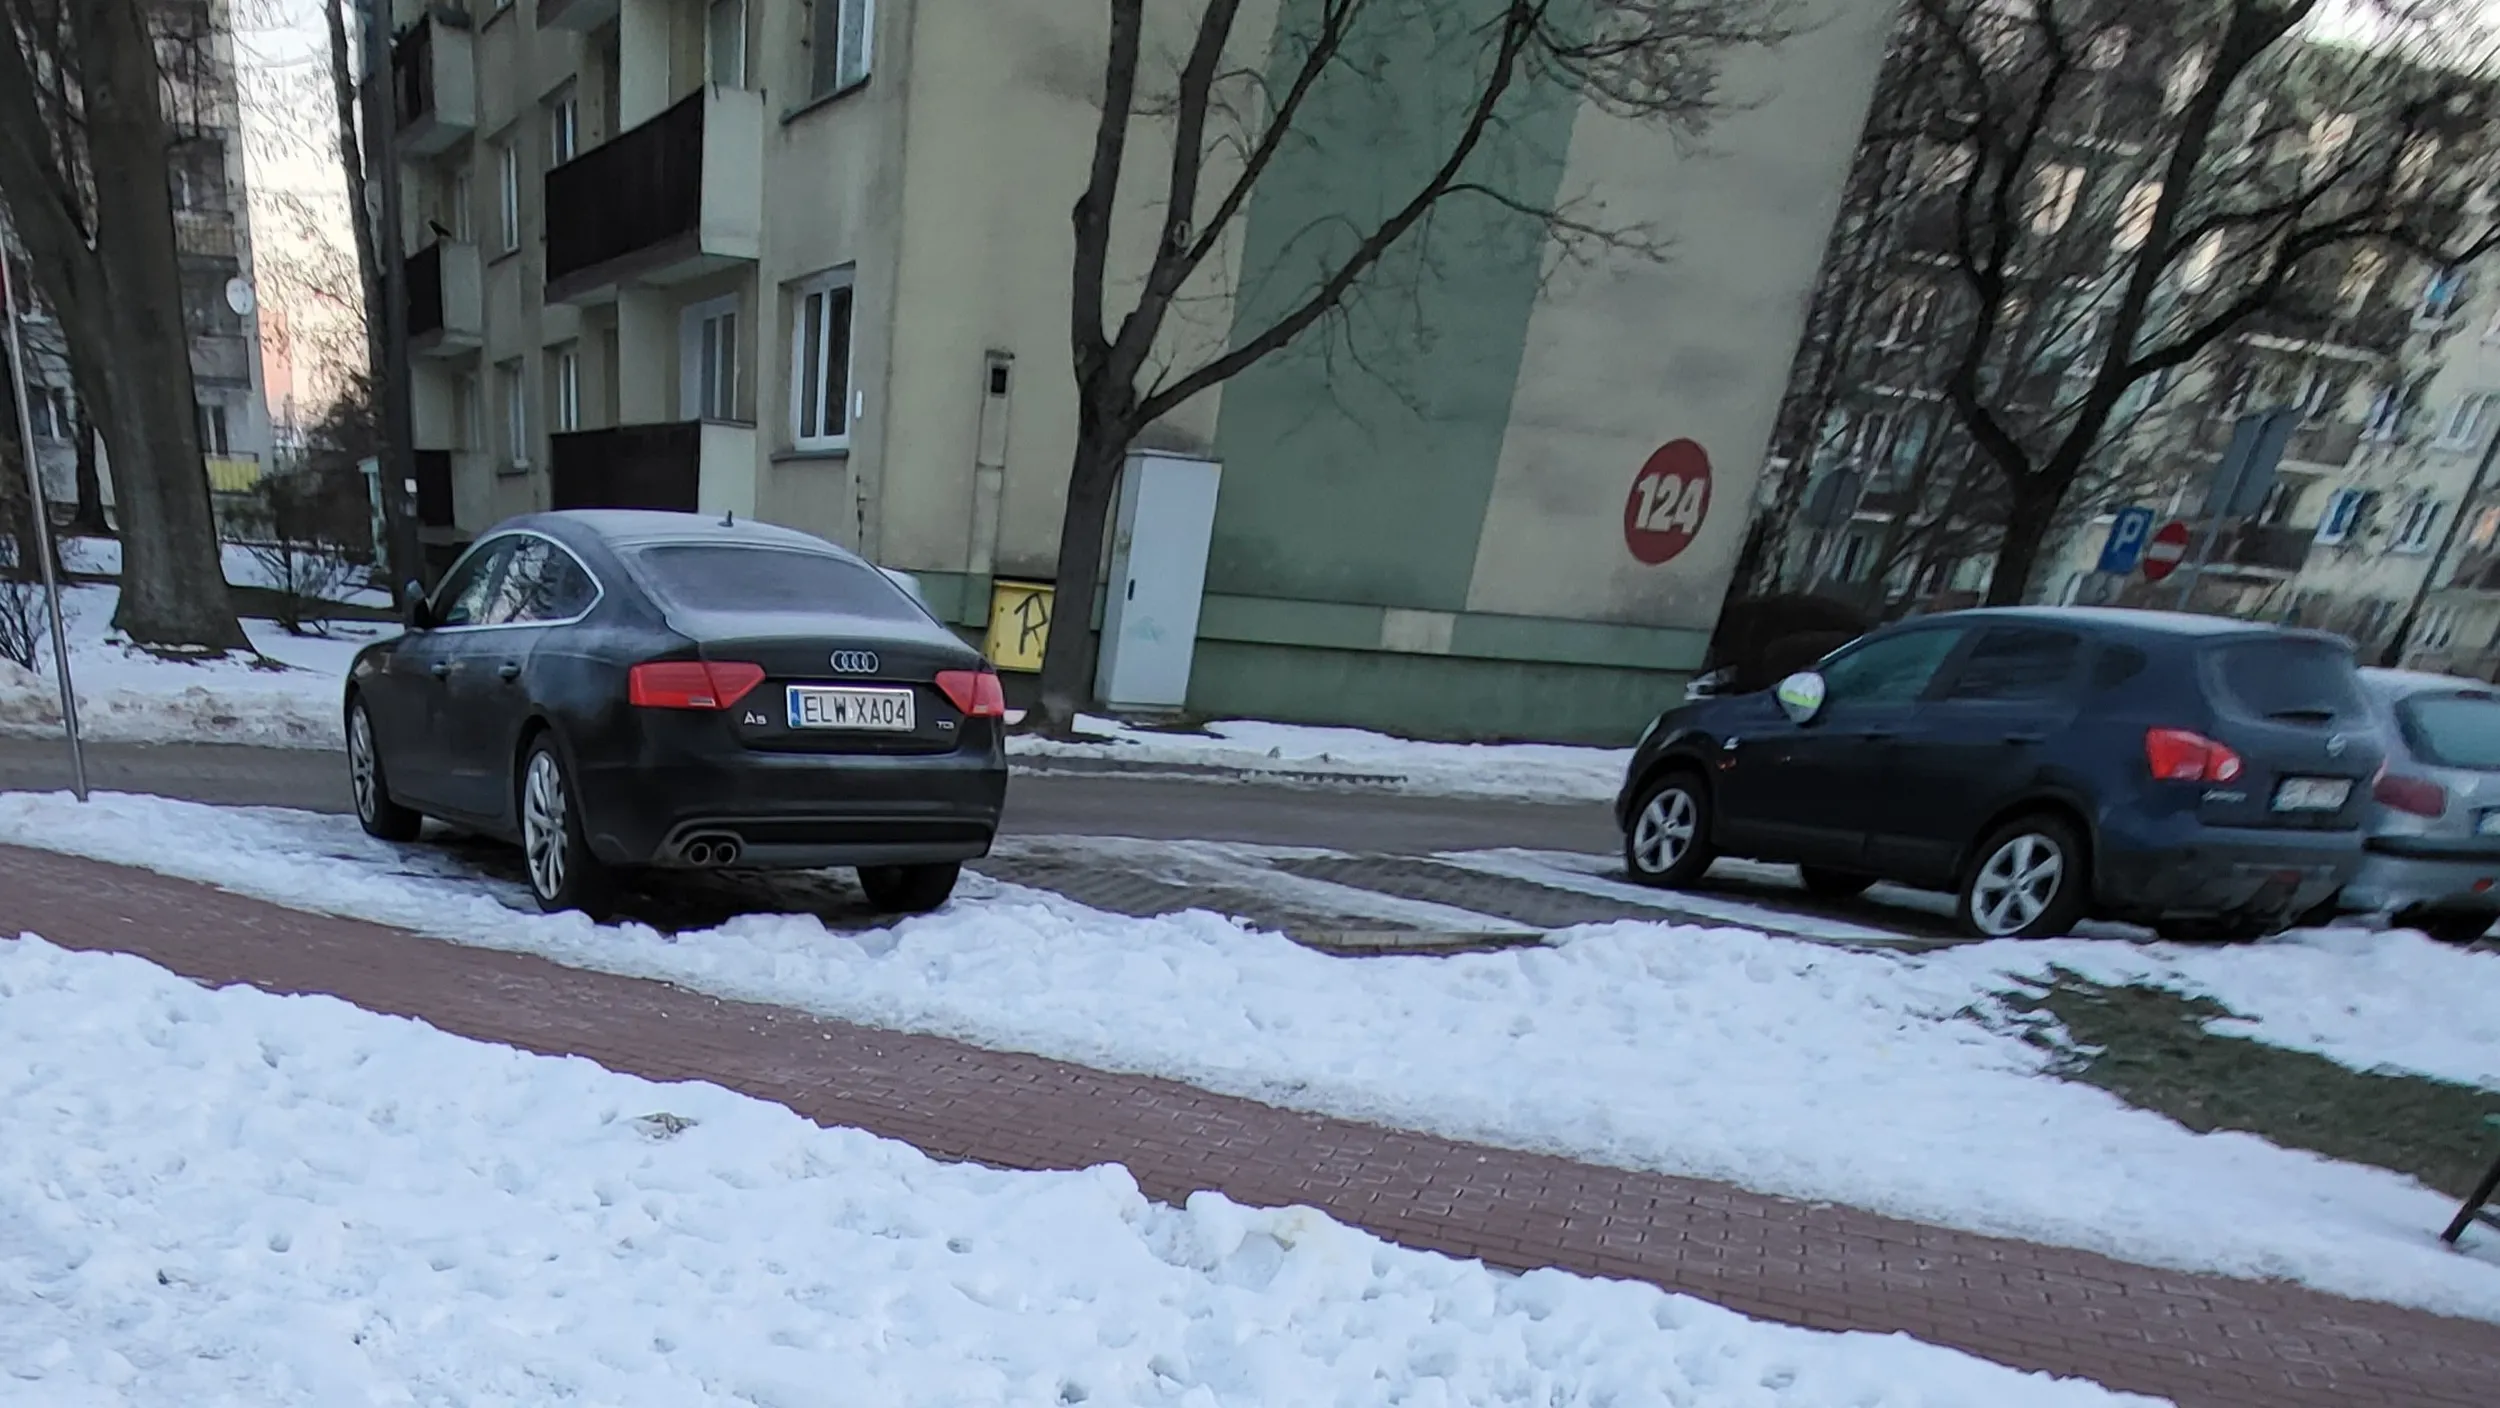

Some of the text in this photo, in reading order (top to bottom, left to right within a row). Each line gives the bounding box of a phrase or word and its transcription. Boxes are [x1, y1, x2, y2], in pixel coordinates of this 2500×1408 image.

[1635, 472, 1705, 534] 124
[2114, 513, 2144, 551] P
[803, 696, 908, 726] ELW XA04
